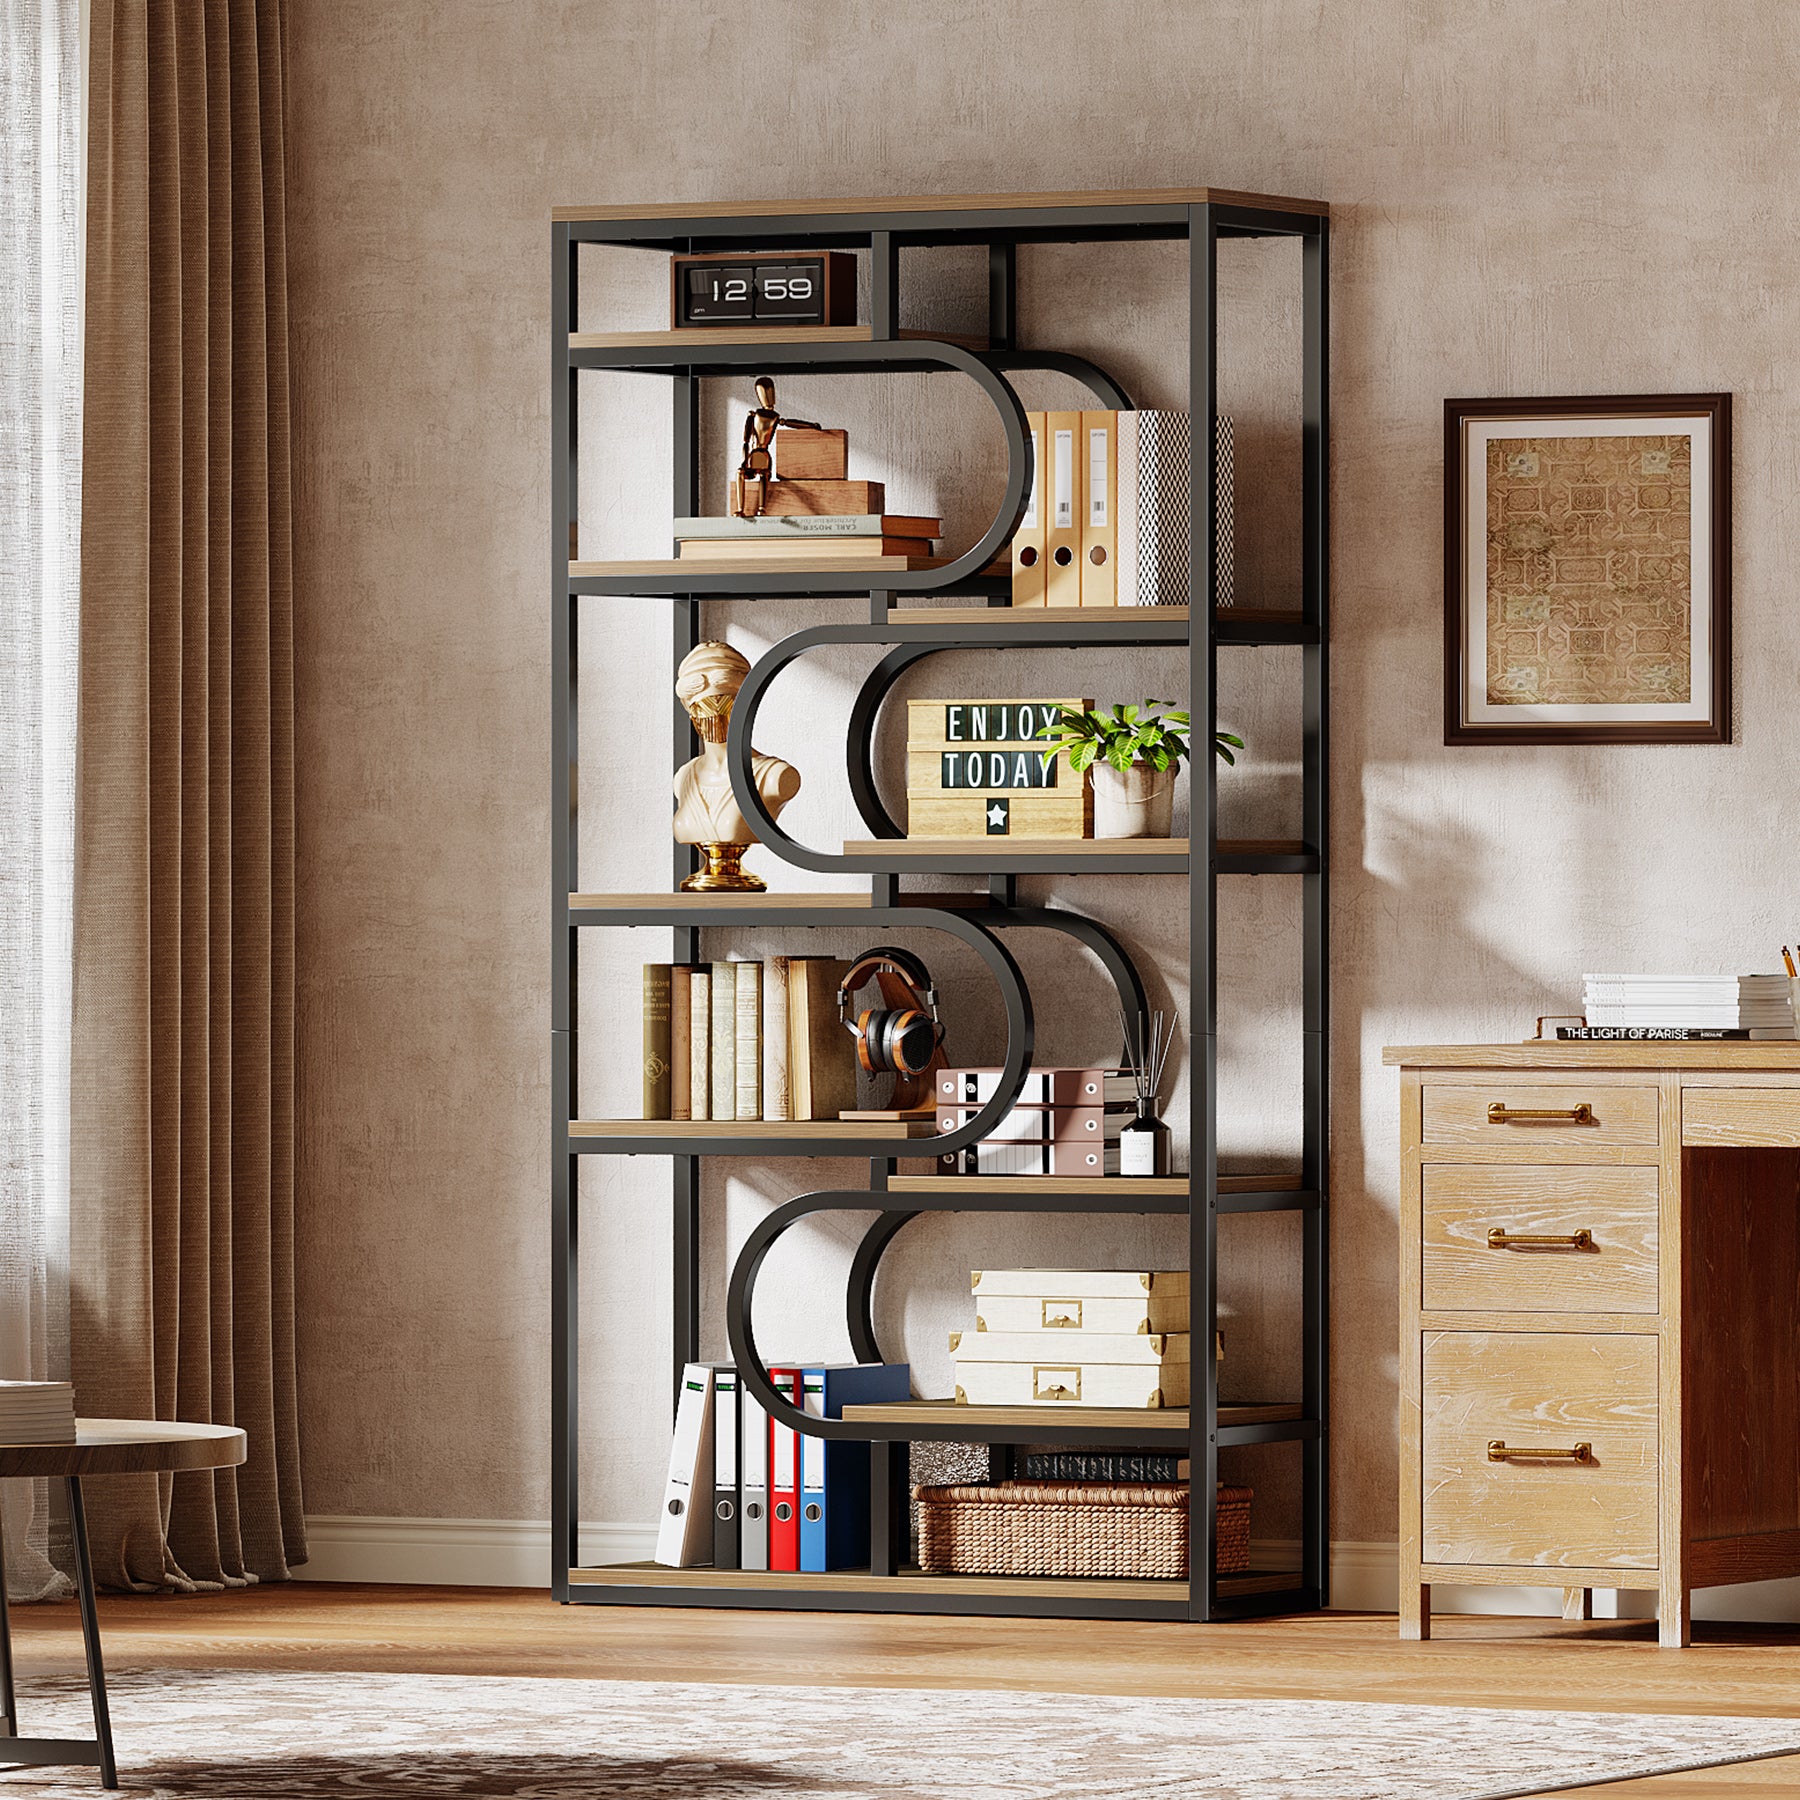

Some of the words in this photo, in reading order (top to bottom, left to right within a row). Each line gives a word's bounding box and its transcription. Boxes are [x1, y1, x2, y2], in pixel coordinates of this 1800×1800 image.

[713, 279, 747, 302] 12
[764, 278, 812, 300] 59
[949, 706, 1057, 741] ENJOY
[945, 752, 1054, 788] TODAY
[1565, 1027, 1588, 1039] THE
[1591, 1028, 1627, 1039] LIGHT
[1628, 1028, 1646, 1039] OF
[1647, 1028, 1689, 1040] PARISE
